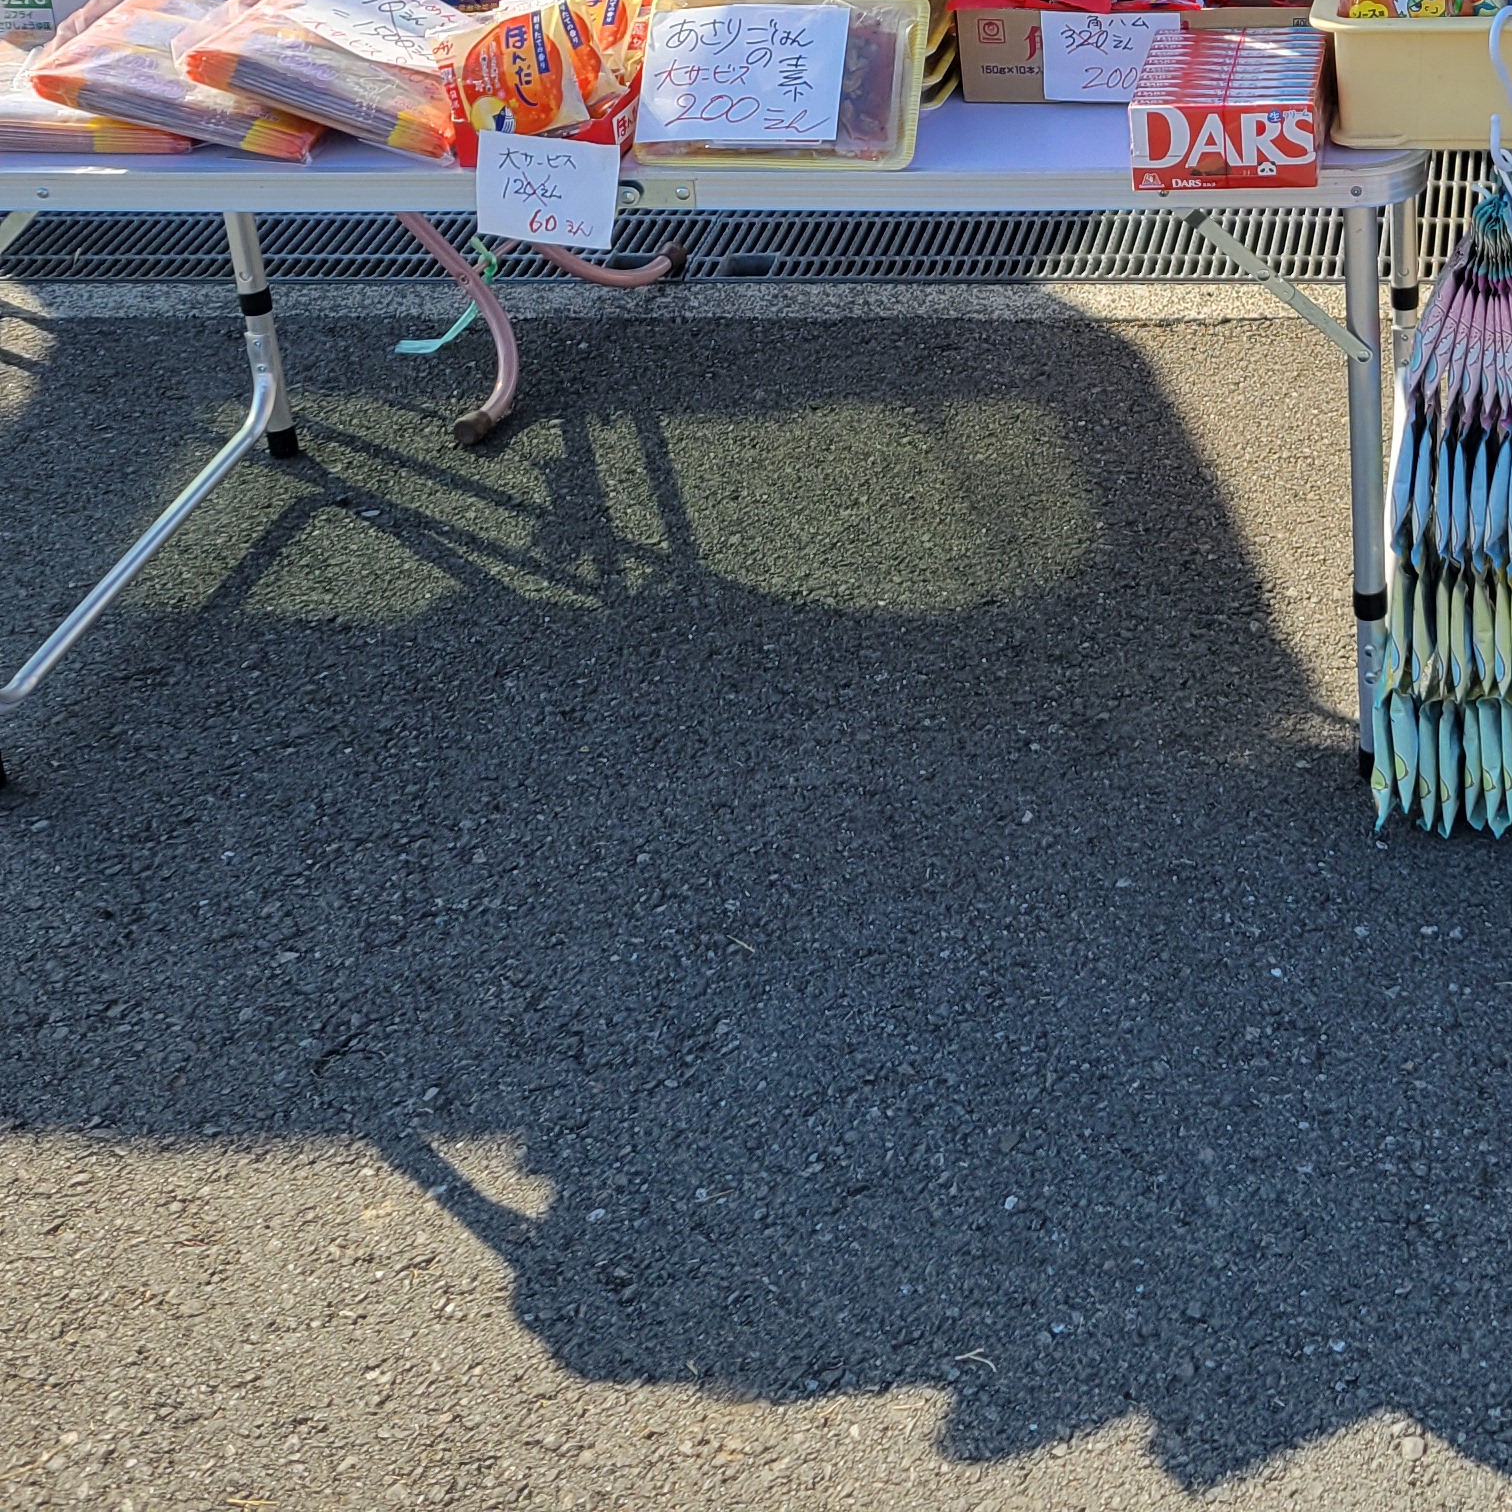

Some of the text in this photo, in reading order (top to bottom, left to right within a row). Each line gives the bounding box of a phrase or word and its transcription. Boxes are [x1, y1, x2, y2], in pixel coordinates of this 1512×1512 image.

[666, 17, 815, 54] あさりごはん
[504, 25, 539, 107] ほんだし
[654, 63, 753, 93] 大サービス
[1081, 65, 1139, 90] 200
[664, 92, 838, 136] 200えん
[1131, 106, 1317, 169] DARS
[498, 147, 578, 171] 大サービス
[1171, 178, 1202, 189] DARS
[528, 208, 594, 238] 60えん
